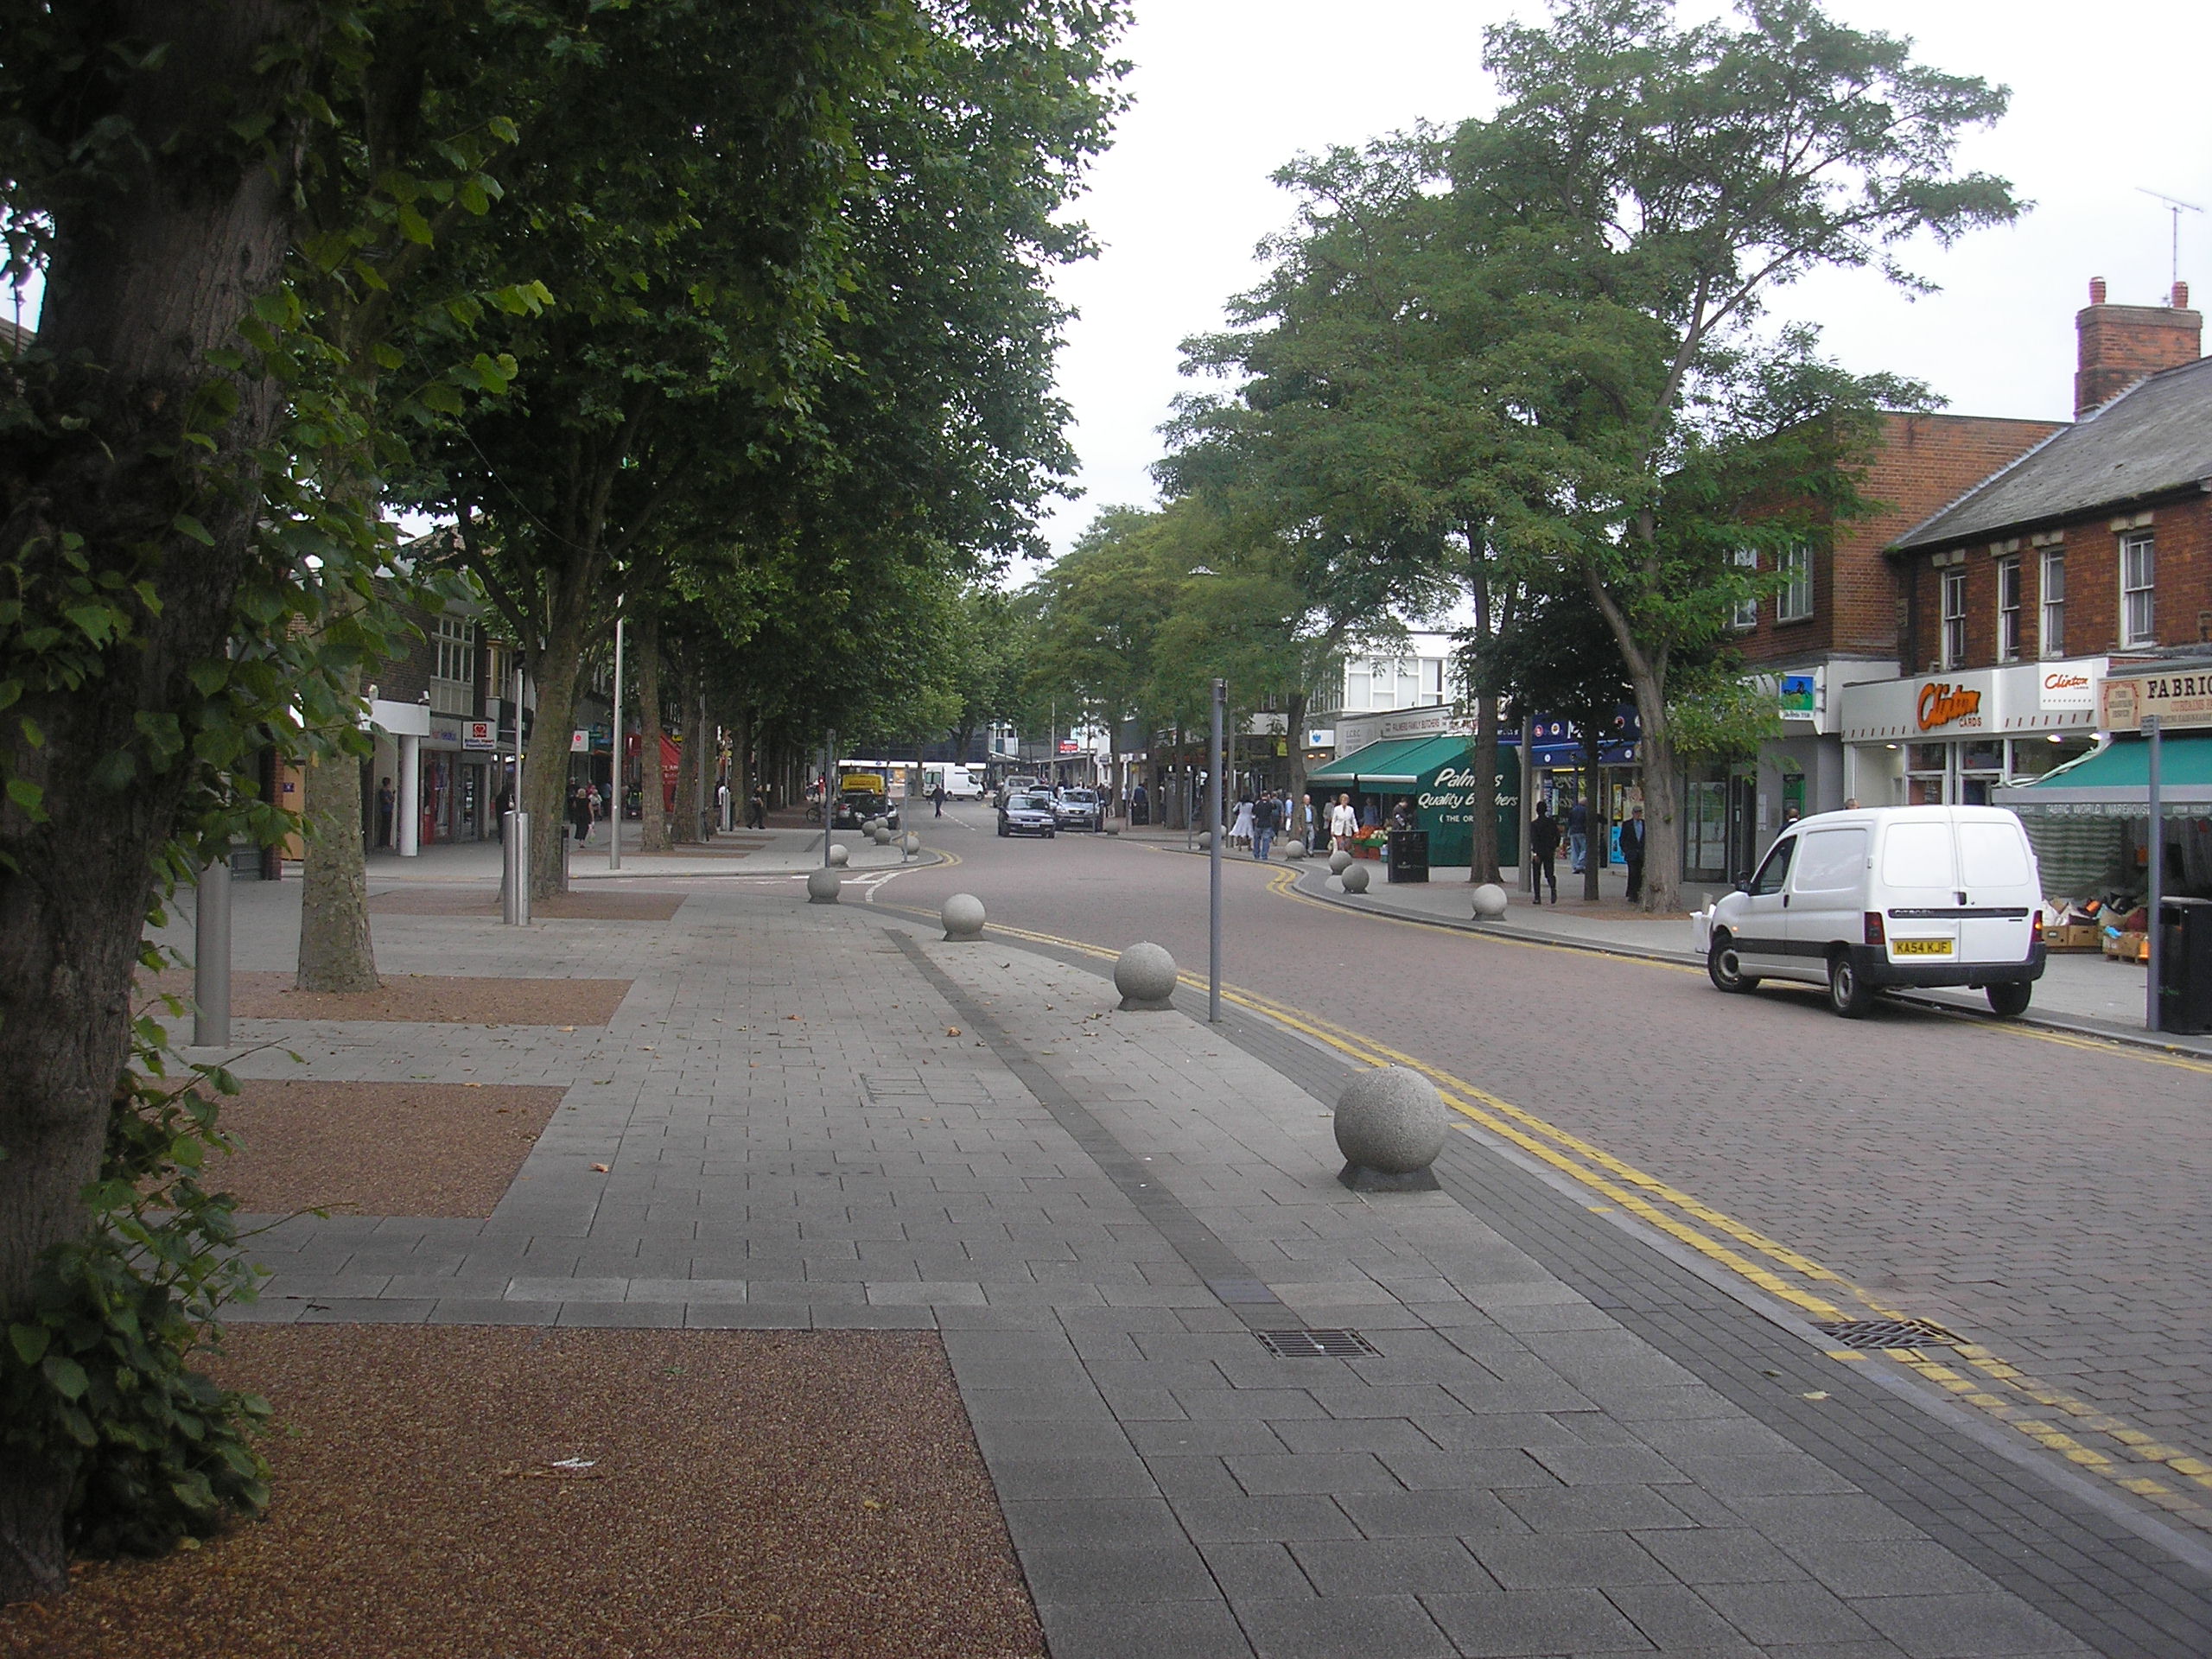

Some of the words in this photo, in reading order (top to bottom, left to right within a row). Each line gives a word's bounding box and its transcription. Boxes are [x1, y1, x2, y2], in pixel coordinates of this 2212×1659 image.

[2044, 674, 2089, 690] Clinton
[1917, 683, 1981, 731] Clinton
[1958, 716, 1982, 728] CARDS
[1434, 767, 1503, 787] Palms
[1418, 792, 1464, 809] Quality
[2046, 804, 2070, 815] FABRIC
[2073, 804, 2101, 815] WORLD
[1896, 942, 1924, 954] KA54
[1926, 941, 1948, 953] KJF
